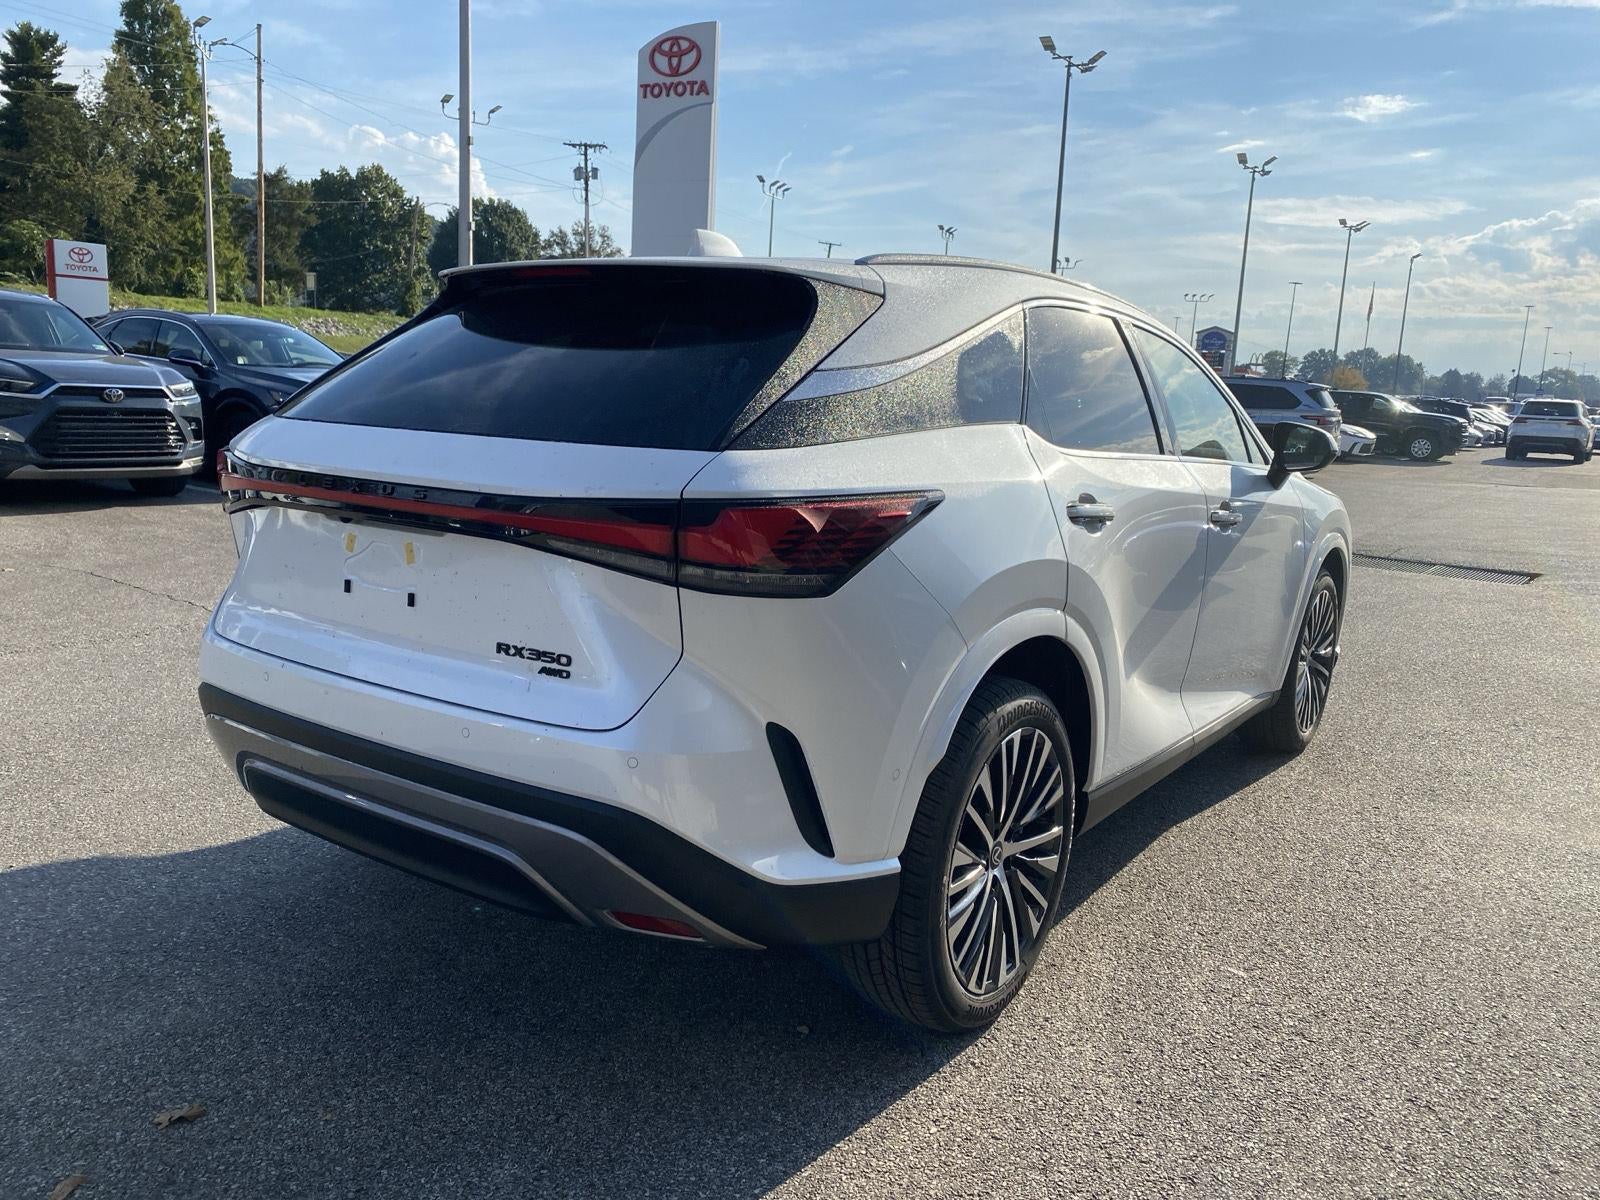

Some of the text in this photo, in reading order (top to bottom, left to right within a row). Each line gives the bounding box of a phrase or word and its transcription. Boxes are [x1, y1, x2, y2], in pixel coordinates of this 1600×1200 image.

[640, 80, 709, 99] TOYOTA
[64, 263, 98, 273] TOYOTA
[537, 666, 571, 679] AWD
